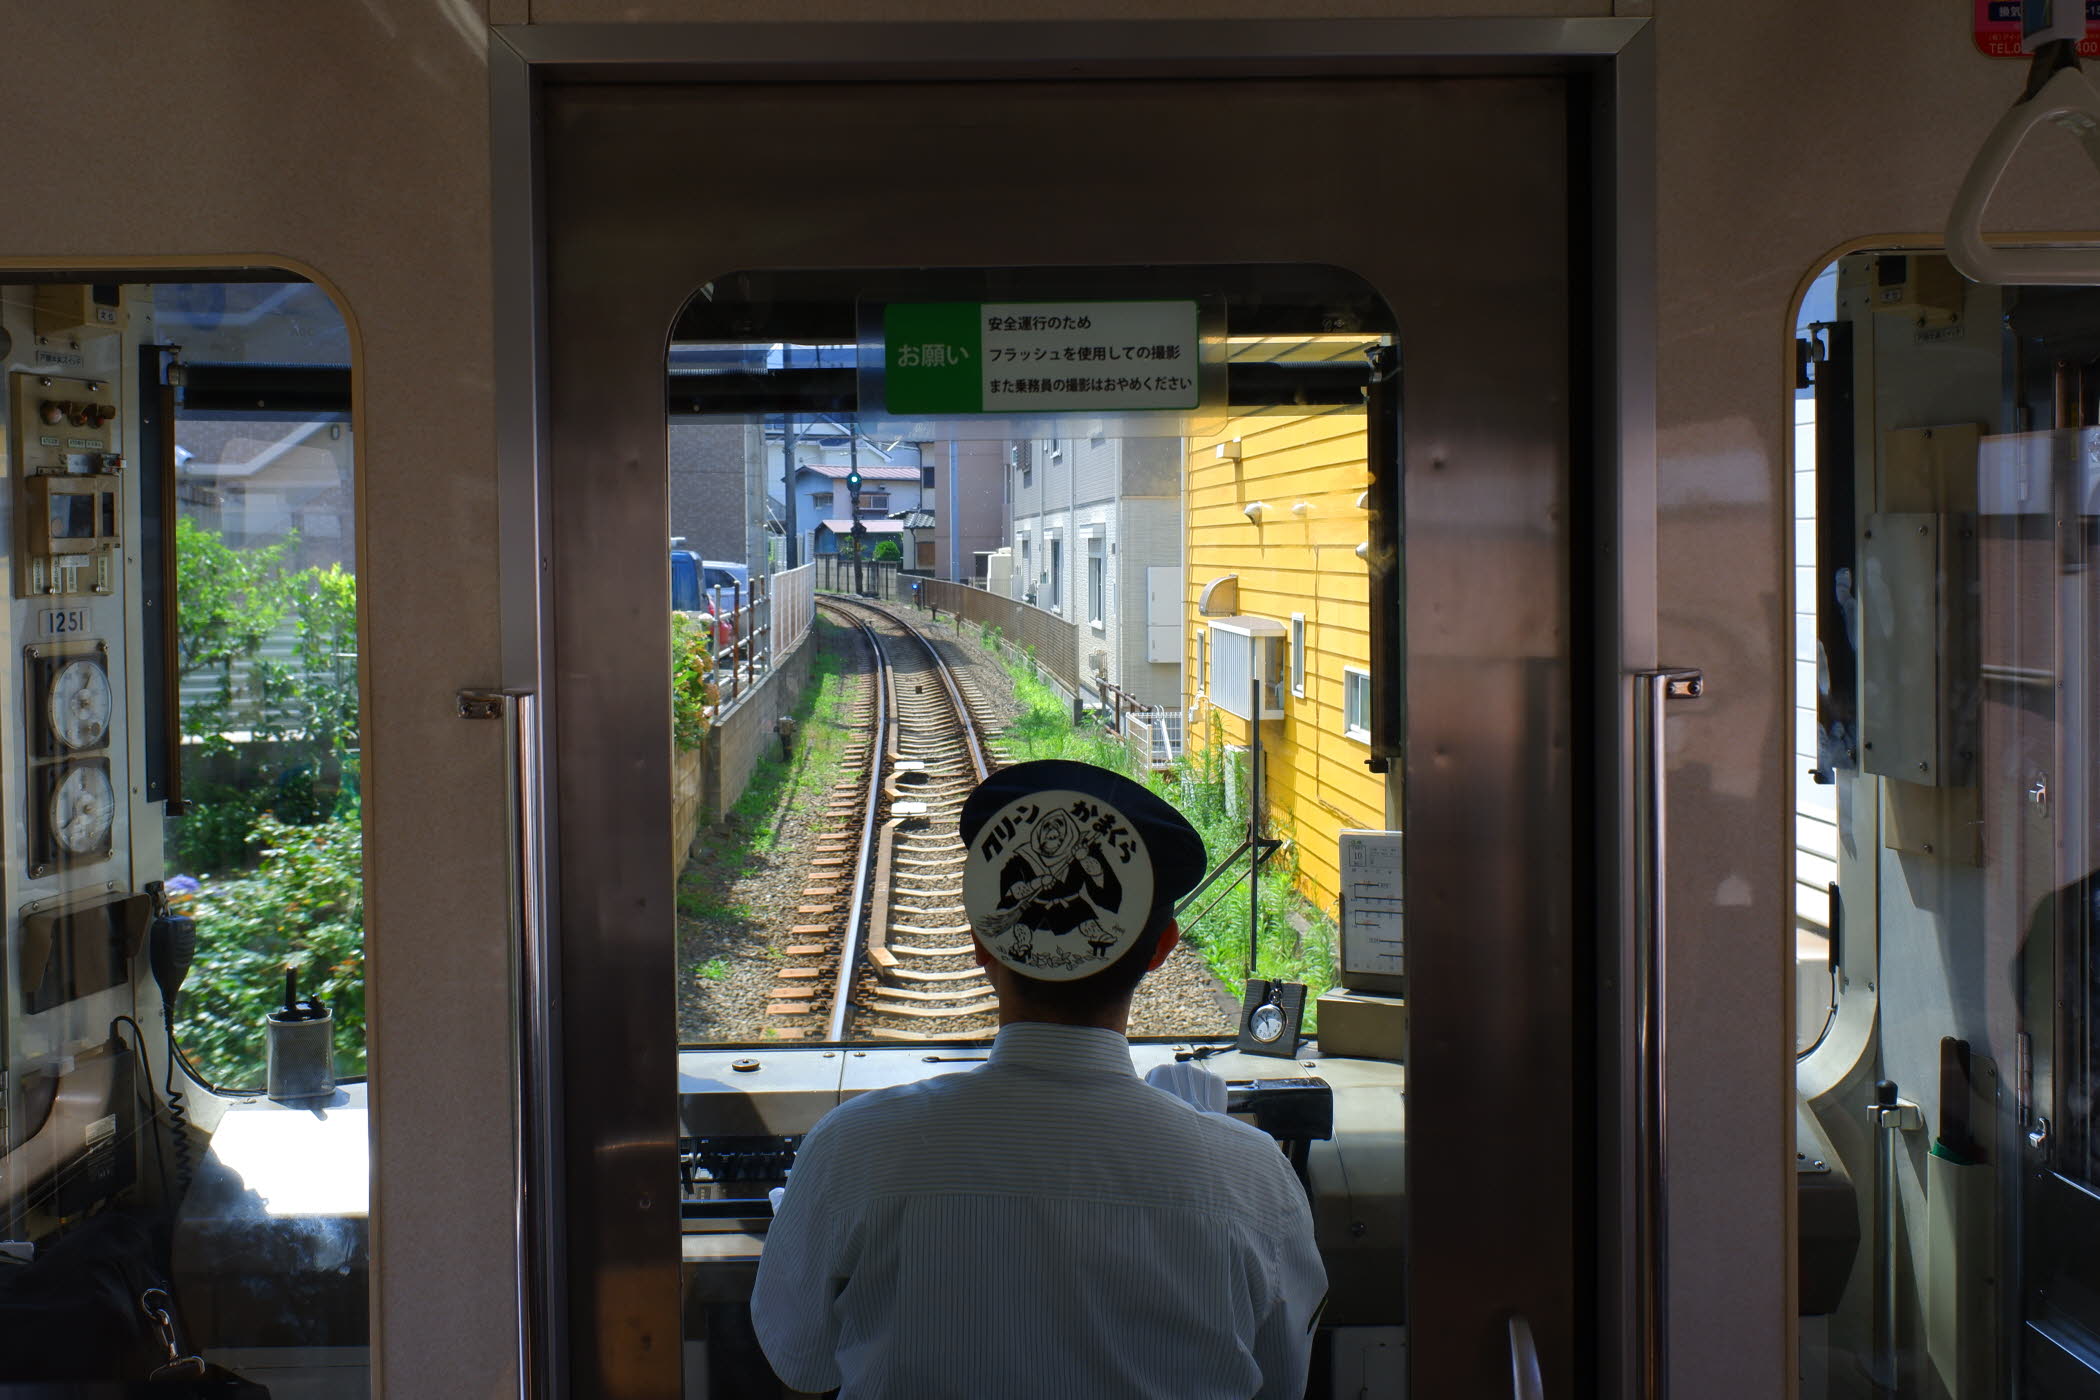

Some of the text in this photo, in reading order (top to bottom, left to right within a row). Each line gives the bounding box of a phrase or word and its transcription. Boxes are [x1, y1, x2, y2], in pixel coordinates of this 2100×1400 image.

[988, 316, 1091, 331] 安全運行のため
[898, 343, 969, 367] お願い
[989, 345, 1181, 362] フラッシュを使用しての撮影
[989, 376, 1192, 394] また乗務員の撮影はおやめください
[50, 611, 83, 633] 1251
[981, 804, 1040, 863] クリーン
[1071, 800, 1136, 863] かまくら
